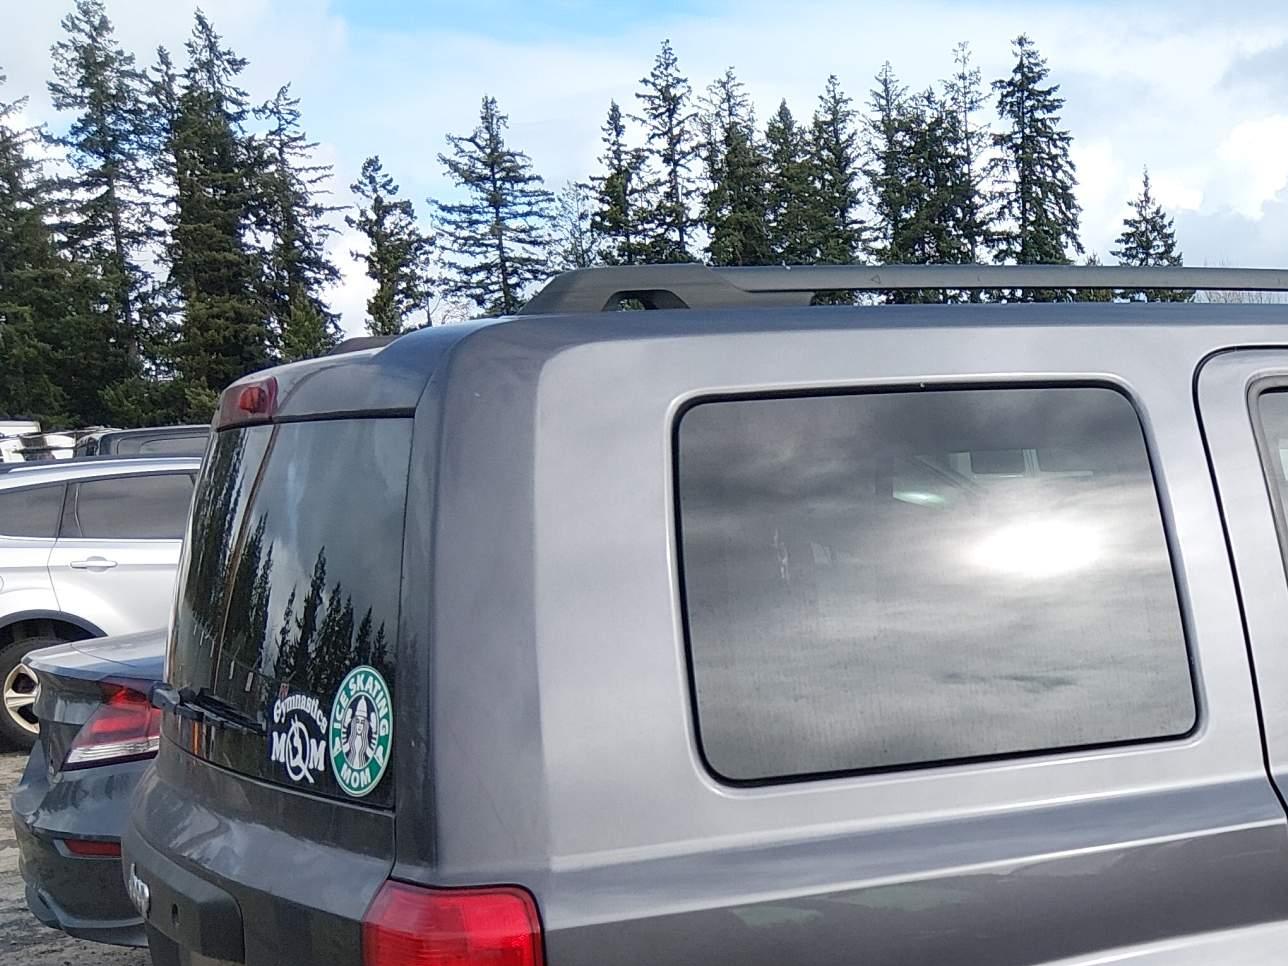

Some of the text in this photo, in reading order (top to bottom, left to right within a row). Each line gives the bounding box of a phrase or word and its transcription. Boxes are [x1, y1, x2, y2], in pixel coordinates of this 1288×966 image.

[273, 694, 328, 734] Gymnastics
[333, 673, 389, 737] ICE SKATING
[341, 763, 371, 788] MOM
